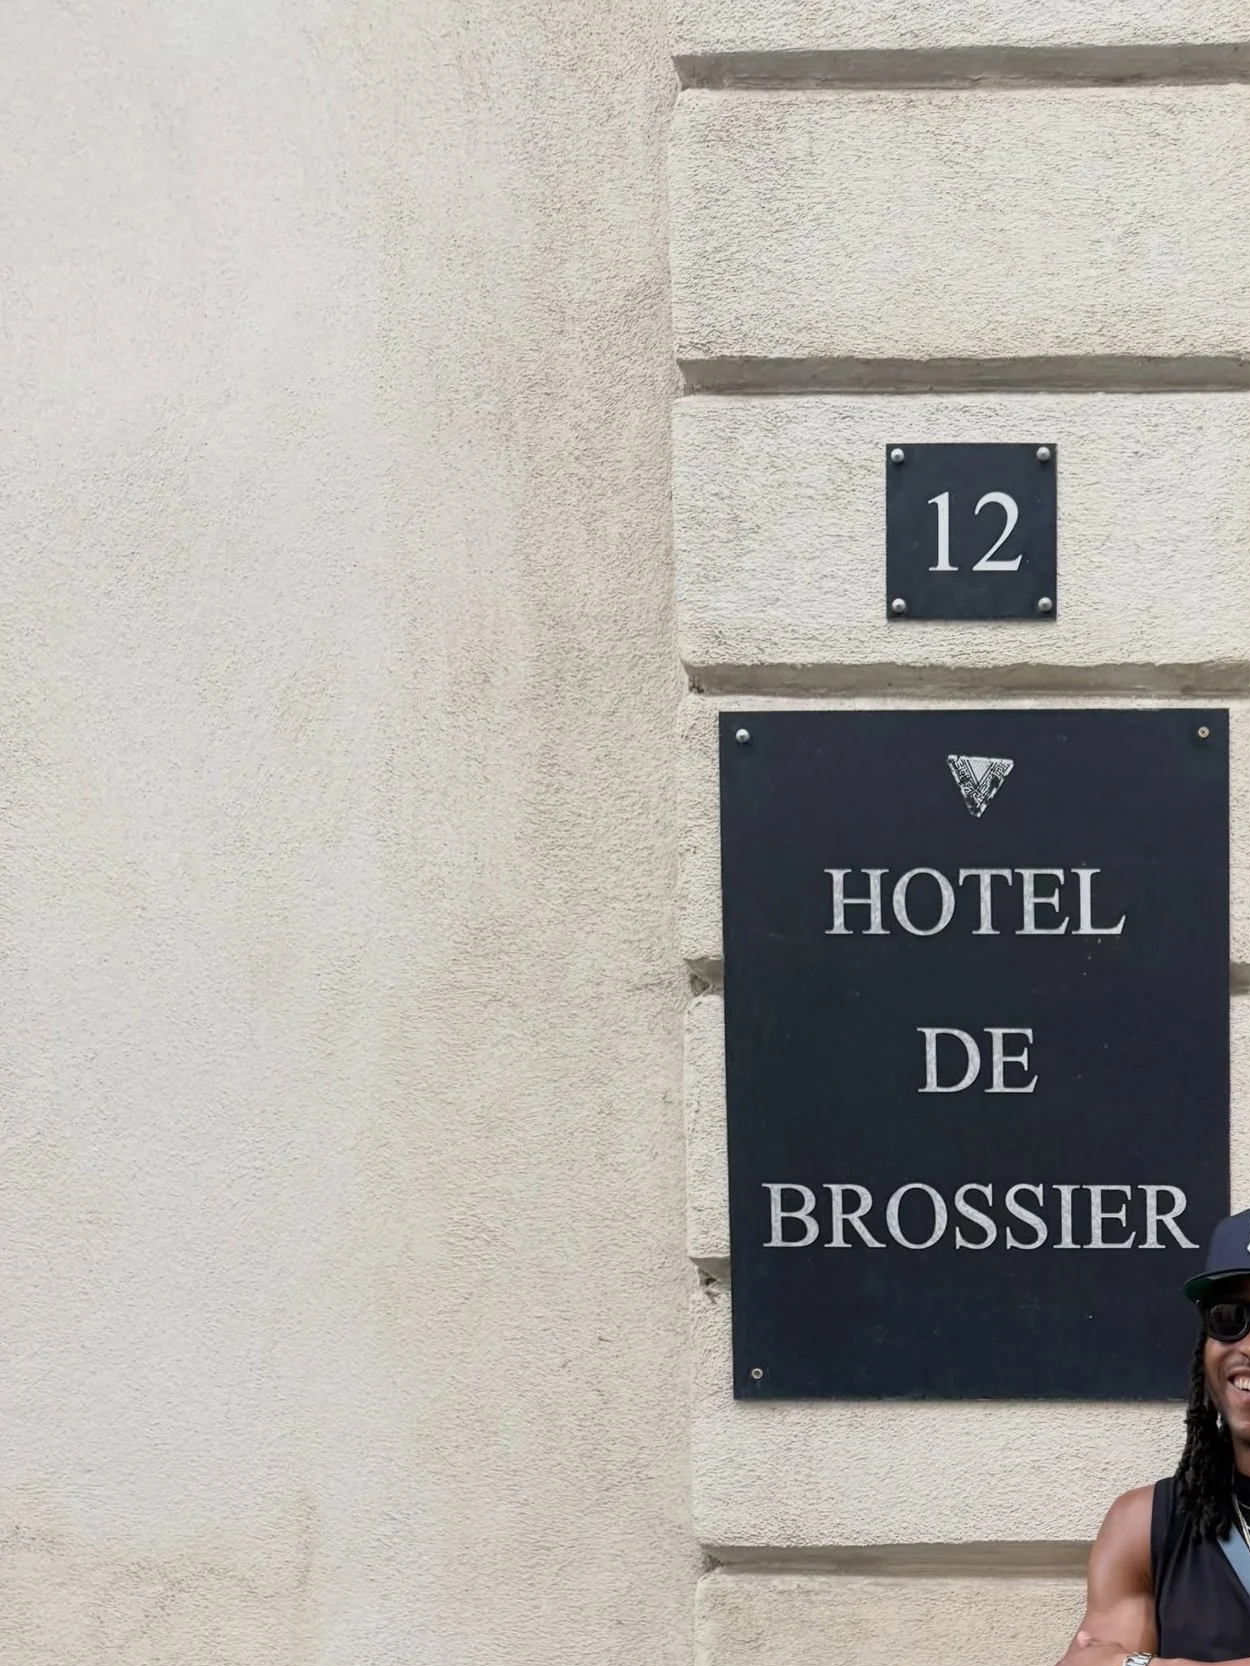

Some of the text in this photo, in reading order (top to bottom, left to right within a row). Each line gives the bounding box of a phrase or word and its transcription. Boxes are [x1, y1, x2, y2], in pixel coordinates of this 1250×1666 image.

[927, 491, 1023, 572] 12
[823, 867, 1126, 935] HOTEL
[916, 1027, 1038, 1093] DE
[761, 1182, 1200, 1250] BROSSIER
